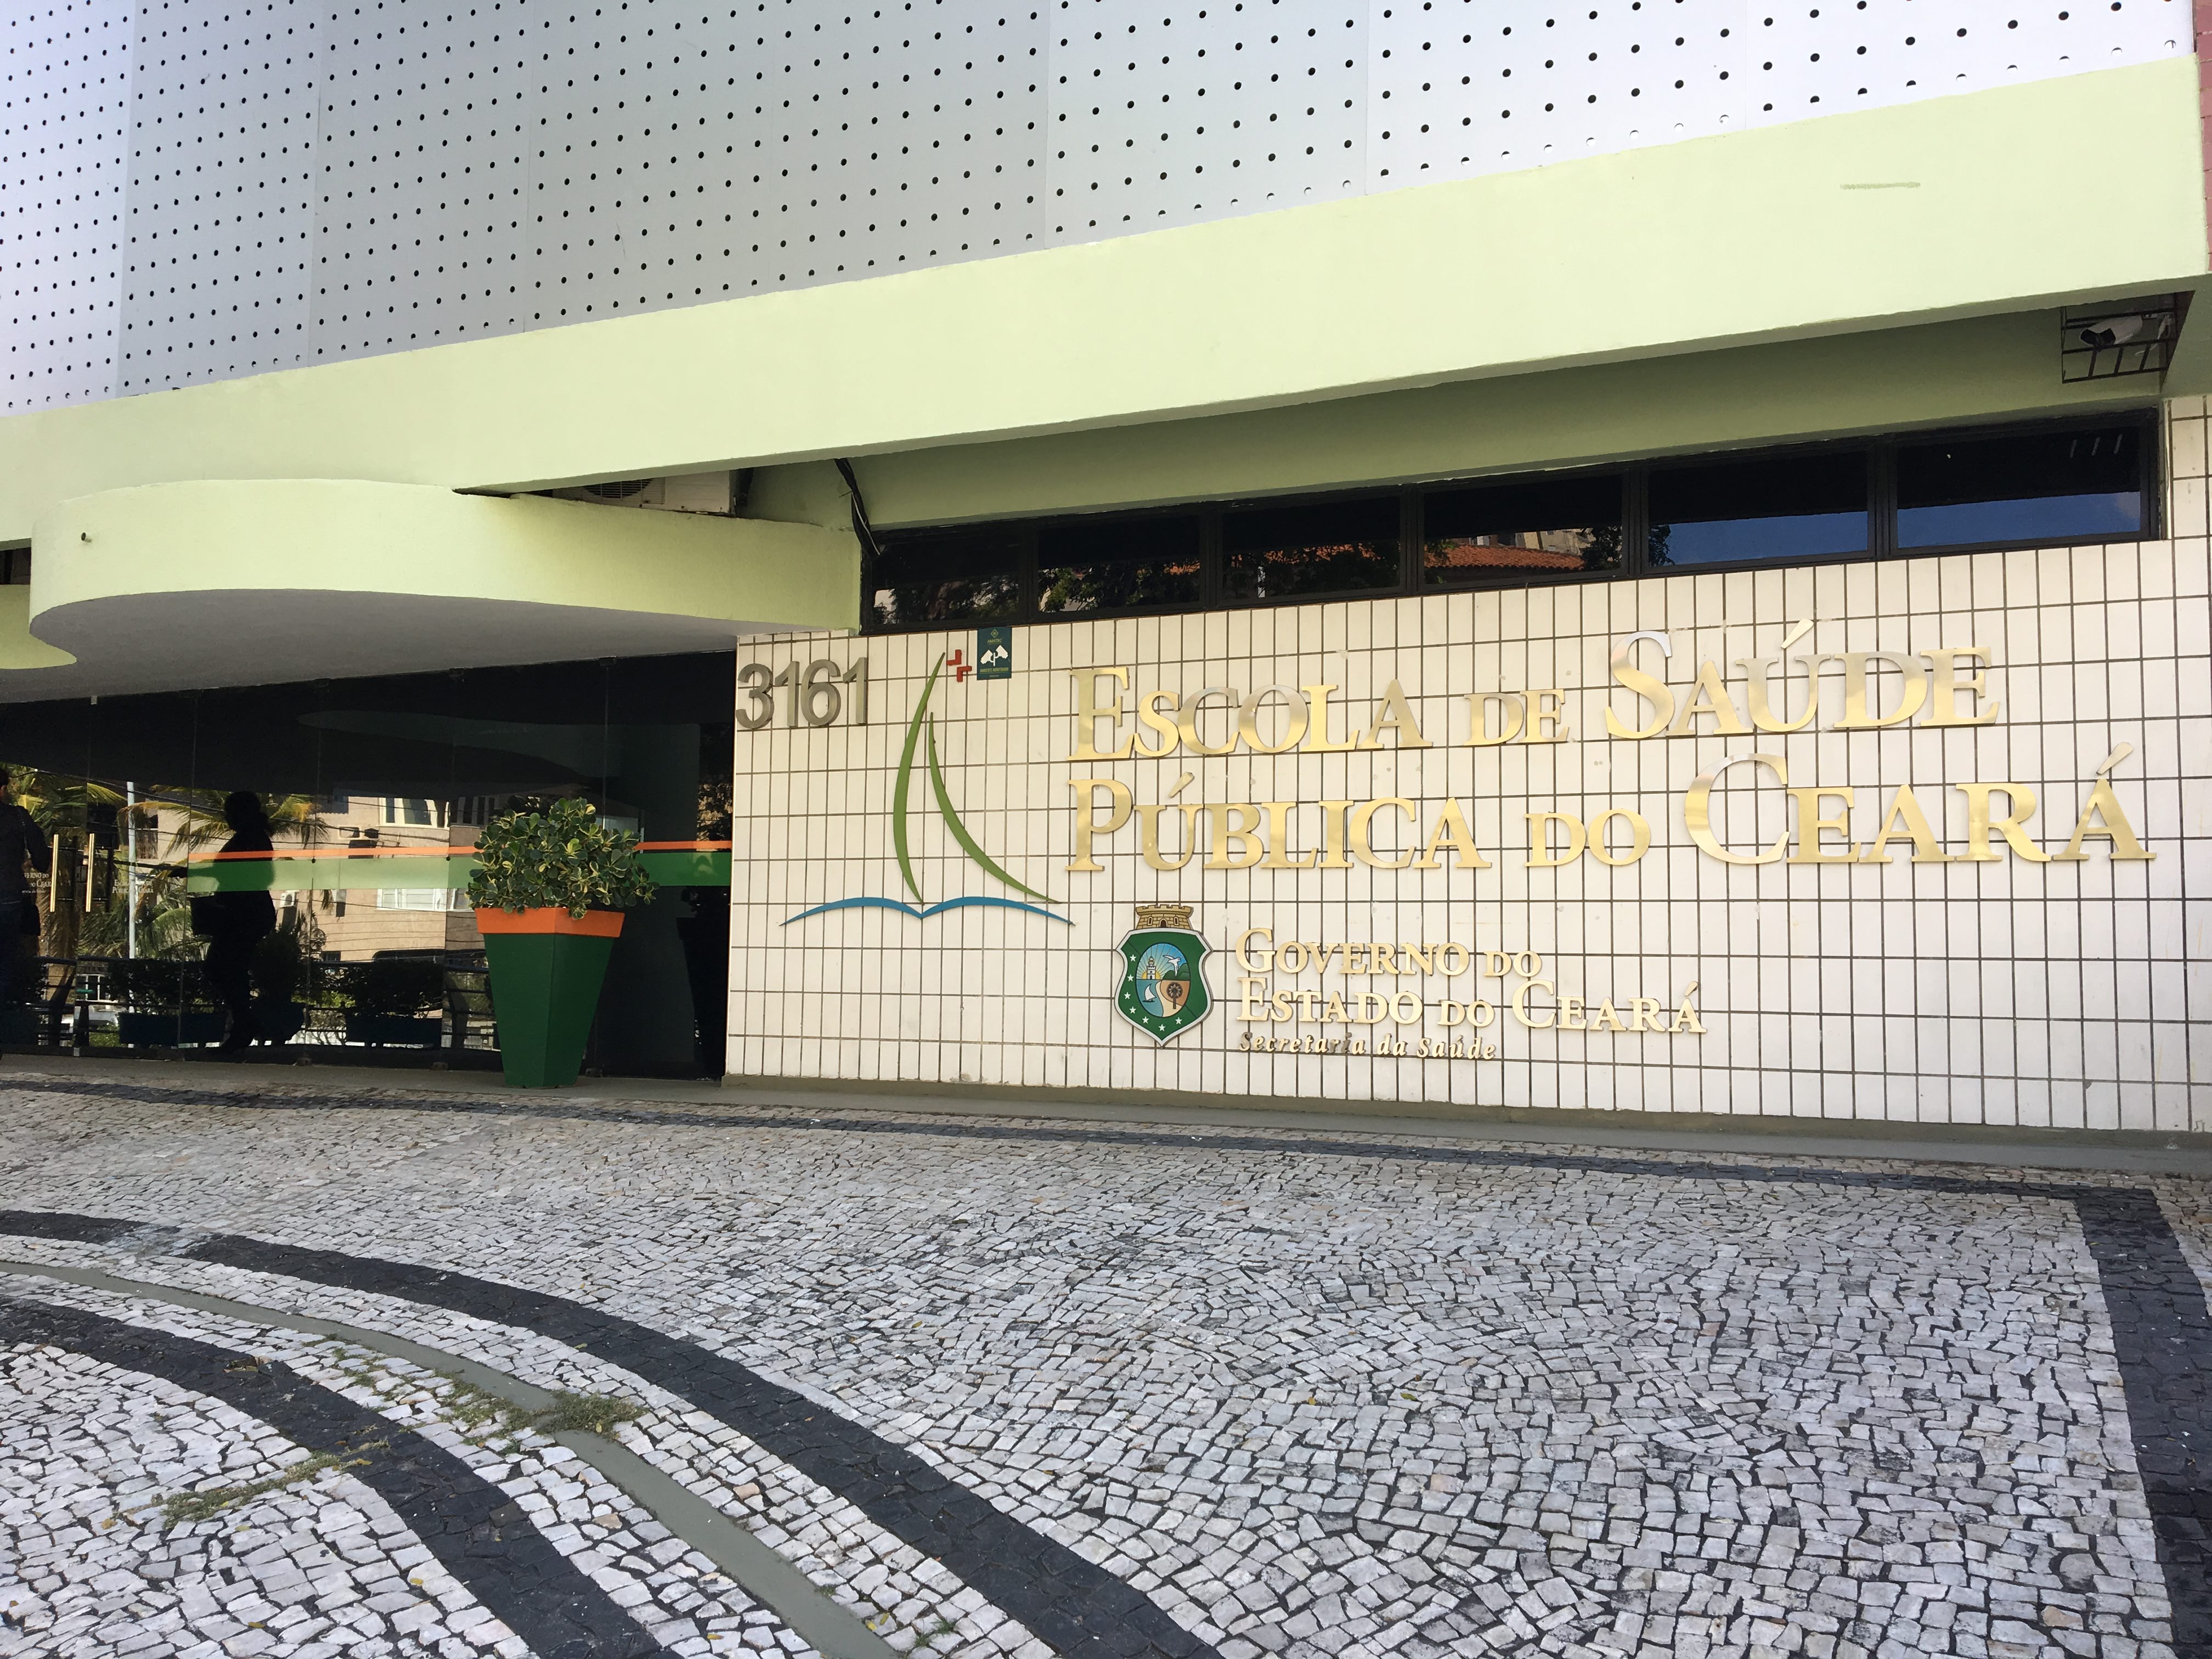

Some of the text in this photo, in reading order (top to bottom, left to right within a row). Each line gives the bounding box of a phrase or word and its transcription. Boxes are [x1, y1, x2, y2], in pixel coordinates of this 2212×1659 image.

[735, 657, 868, 729] 3161
[1067, 618, 2000, 761] ESCOLA DE SAÚDE
[1065, 742, 2157, 871] PÚBLICA DO CEARÁ
[1235, 927, 1542, 978] GOVERNO DO
[1237, 977, 1708, 1034] ESTADO DO CEARÁ
[1238, 1031, 1497, 1060] Secretaria da Saúde
